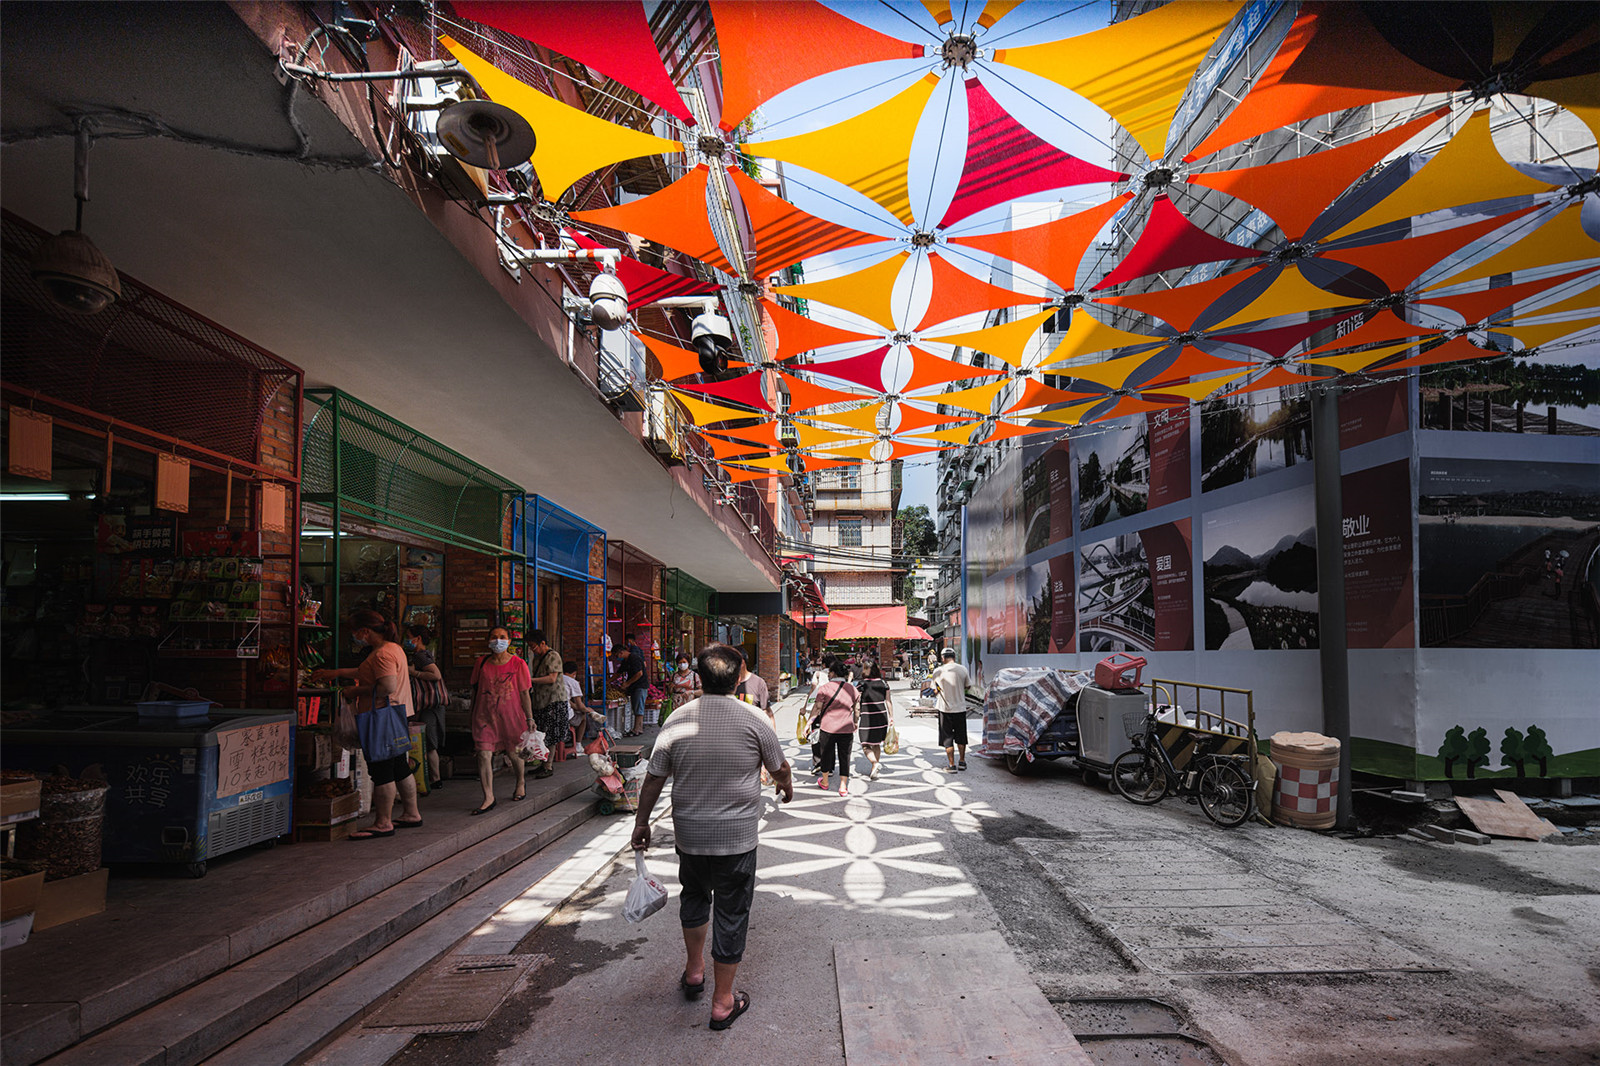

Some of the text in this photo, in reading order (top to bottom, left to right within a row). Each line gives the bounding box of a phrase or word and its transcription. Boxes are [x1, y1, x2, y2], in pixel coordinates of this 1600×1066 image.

[1153, 408, 1170, 430] 文明
[1342, 514, 1371, 539] 敬业
[1156, 554, 1172, 572] 爱国
[126, 763, 170, 786] 欢乐
[124, 784, 171, 808] 共享
